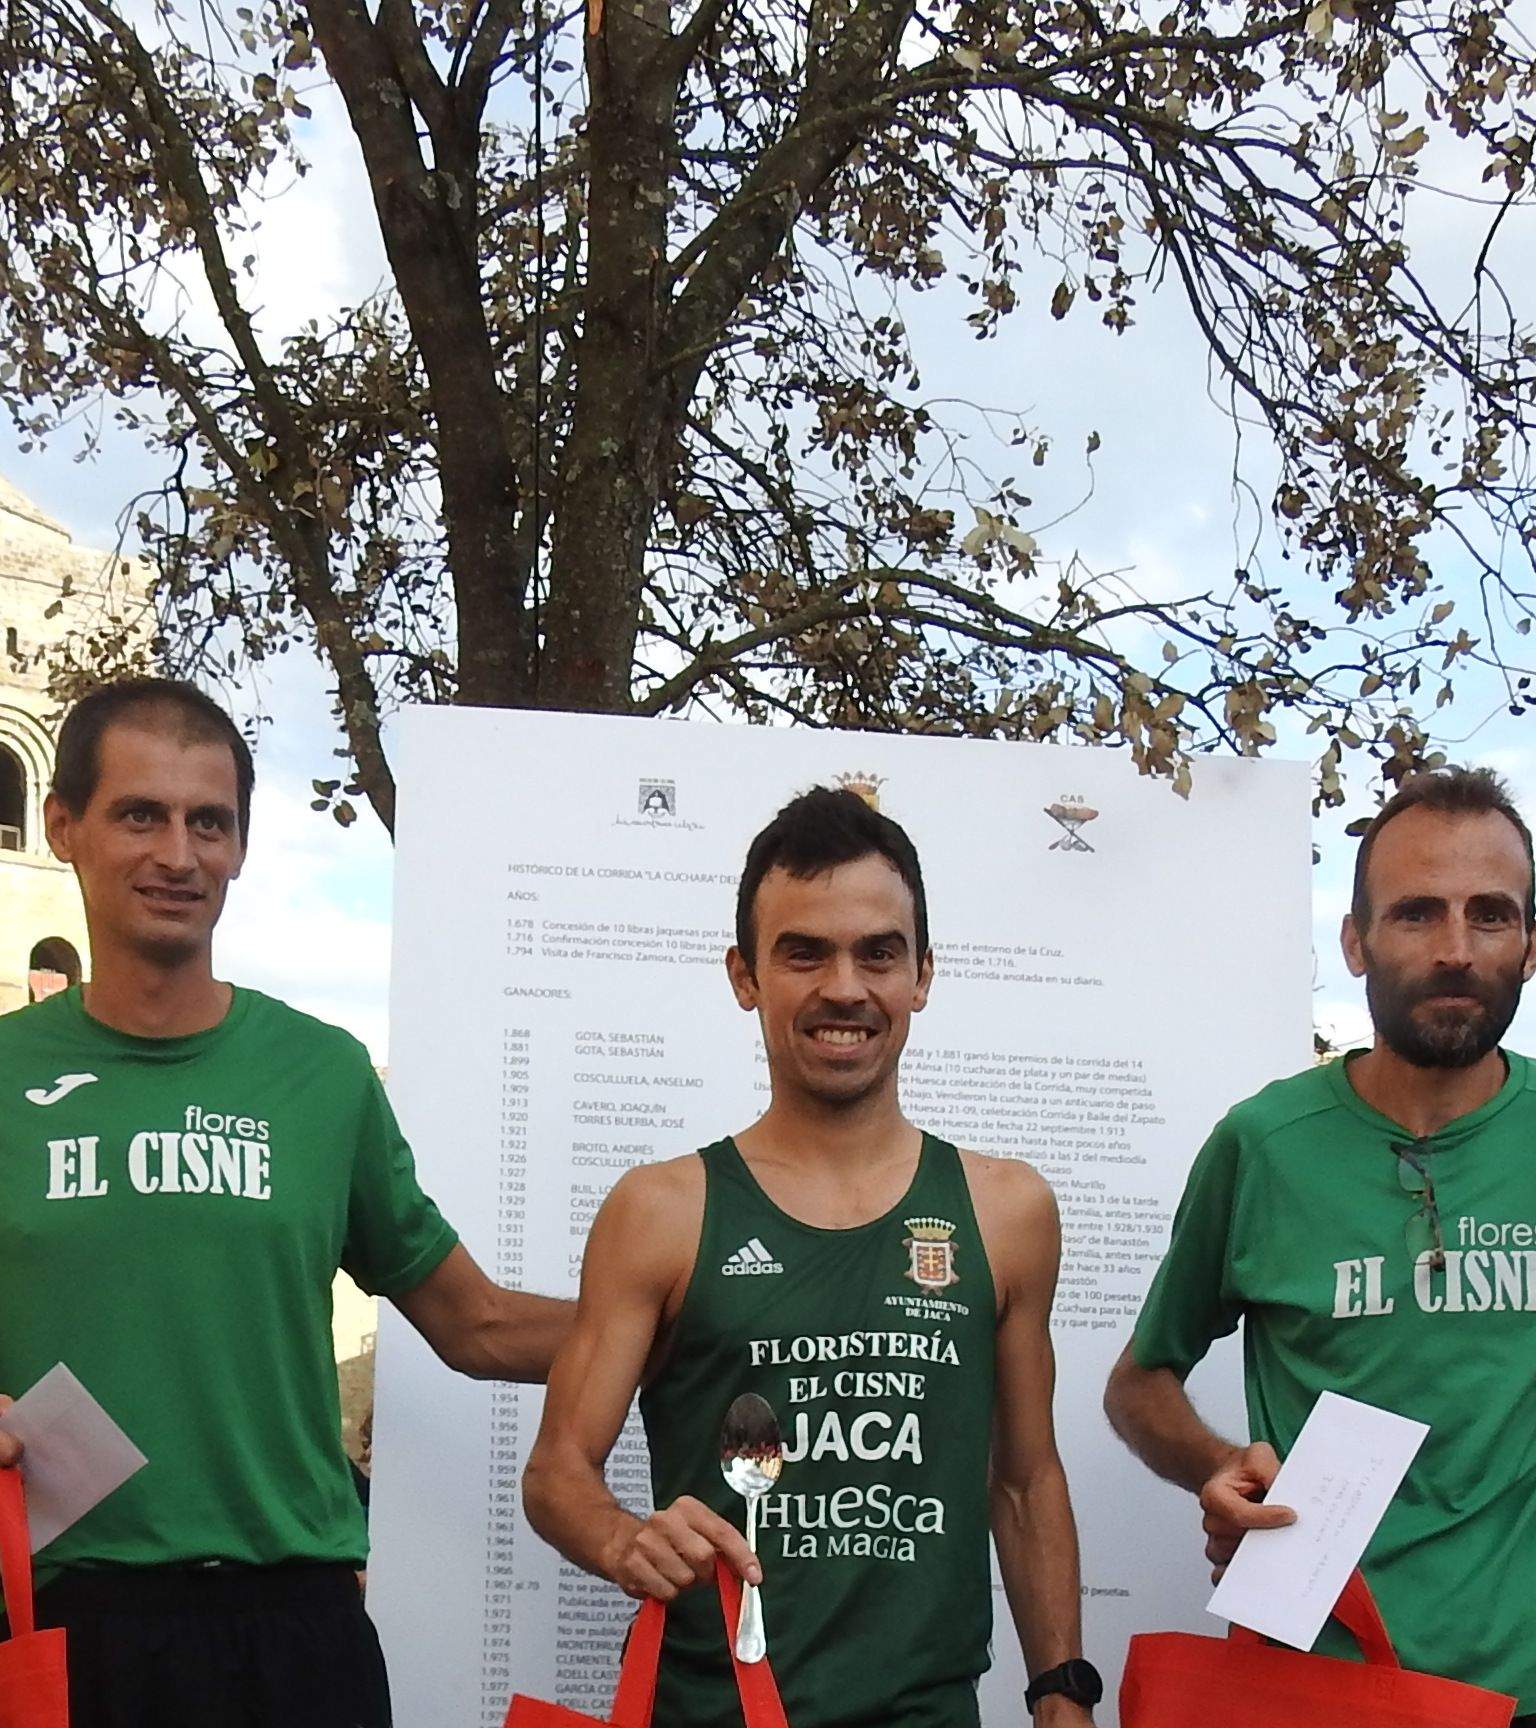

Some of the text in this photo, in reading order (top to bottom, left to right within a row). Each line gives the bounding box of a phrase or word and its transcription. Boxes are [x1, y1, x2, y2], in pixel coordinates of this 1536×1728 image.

[508, 863, 563, 876] HISTÓRICO
[566, 867, 579, 877] DE
[582, 867, 595, 877] LA
[597, 869, 643, 880] CORRIDA
[720, 875, 739, 885] DEL
[507, 890, 539, 902] AÑOS:
[542, 920, 594, 931] Concesión
[597, 923, 610, 932] de
[614, 923, 625, 933] 10
[627, 924, 654, 935] libras
[656, 926, 700, 938] jaquesas
[702, 930, 719, 939] por
[542, 933, 610, 946] Confirmación
[612, 937, 663, 948] concesión
[666, 940, 678, 949] 10
[680, 940, 706, 951] libras
[959, 942, 970, 952] el
[972, 944, 1011, 954] entorno
[1014, 945, 1026, 955] de
[1029, 946, 1037, 956] la
[1040, 947, 1064, 958] Cruz.
[542, 947, 568, 957] Visita
[571, 948, 584, 959] de
[586, 949, 633, 961] Francisco
[972, 957, 985, 966] de
[938, 968, 951, 978] de
[954, 969, 962, 979] la
[964, 970, 1000, 980] Corrida
[1003, 972, 1043, 984] anotada
[1045, 976, 1058, 984] en
[1074, 976, 1103, 986] diario.
[504, 986, 571, 999] GANADORES:
[608, 1032, 665, 1045] SEBASTIÁN
[608, 1046, 664, 1058] SEBASTIÁN
[992, 1051, 1006, 1061] los
[1009, 1054, 1048, 1064] premios
[1051, 1056, 1063, 1064] de
[1066, 1056, 1074, 1065] la
[1076, 1058, 1110, 1068] corrida
[1113, 1060, 1128, 1068] del
[963, 1065, 1006, 1075] cucharas
[1009, 1066, 1021, 1075] de
[1024, 1066, 1048, 1077] plata
[1075, 1072, 1090, 1080] par
[1092, 1072, 1105, 1080] de
[652, 1076, 703, 1088] ANSELMO
[911, 1076, 1152, 1097] Huesca celebración de la Corrida, muy competida
[185, 1105, 270, 1141] flores
[573, 1115, 612, 1126] TORRES
[46, 1131, 271, 1200] EL CISNE
[721, 1261, 784, 1276] adidas
[1332, 1256, 1394, 1319] EL
[1069, 1291, 1081, 1299] de
[1104, 1292, 1141, 1302] pesetas
[884, 1295, 969, 1316] AYUNTAMIENTO
[1057, 1303, 1121, 1316] Cuchara para
[905, 1307, 951, 1322] DE JACA
[749, 1330, 961, 1367] FLORISTERÍA
[789, 1371, 926, 1403] EL CISNE
[781, 1411, 923, 1465] JACA
